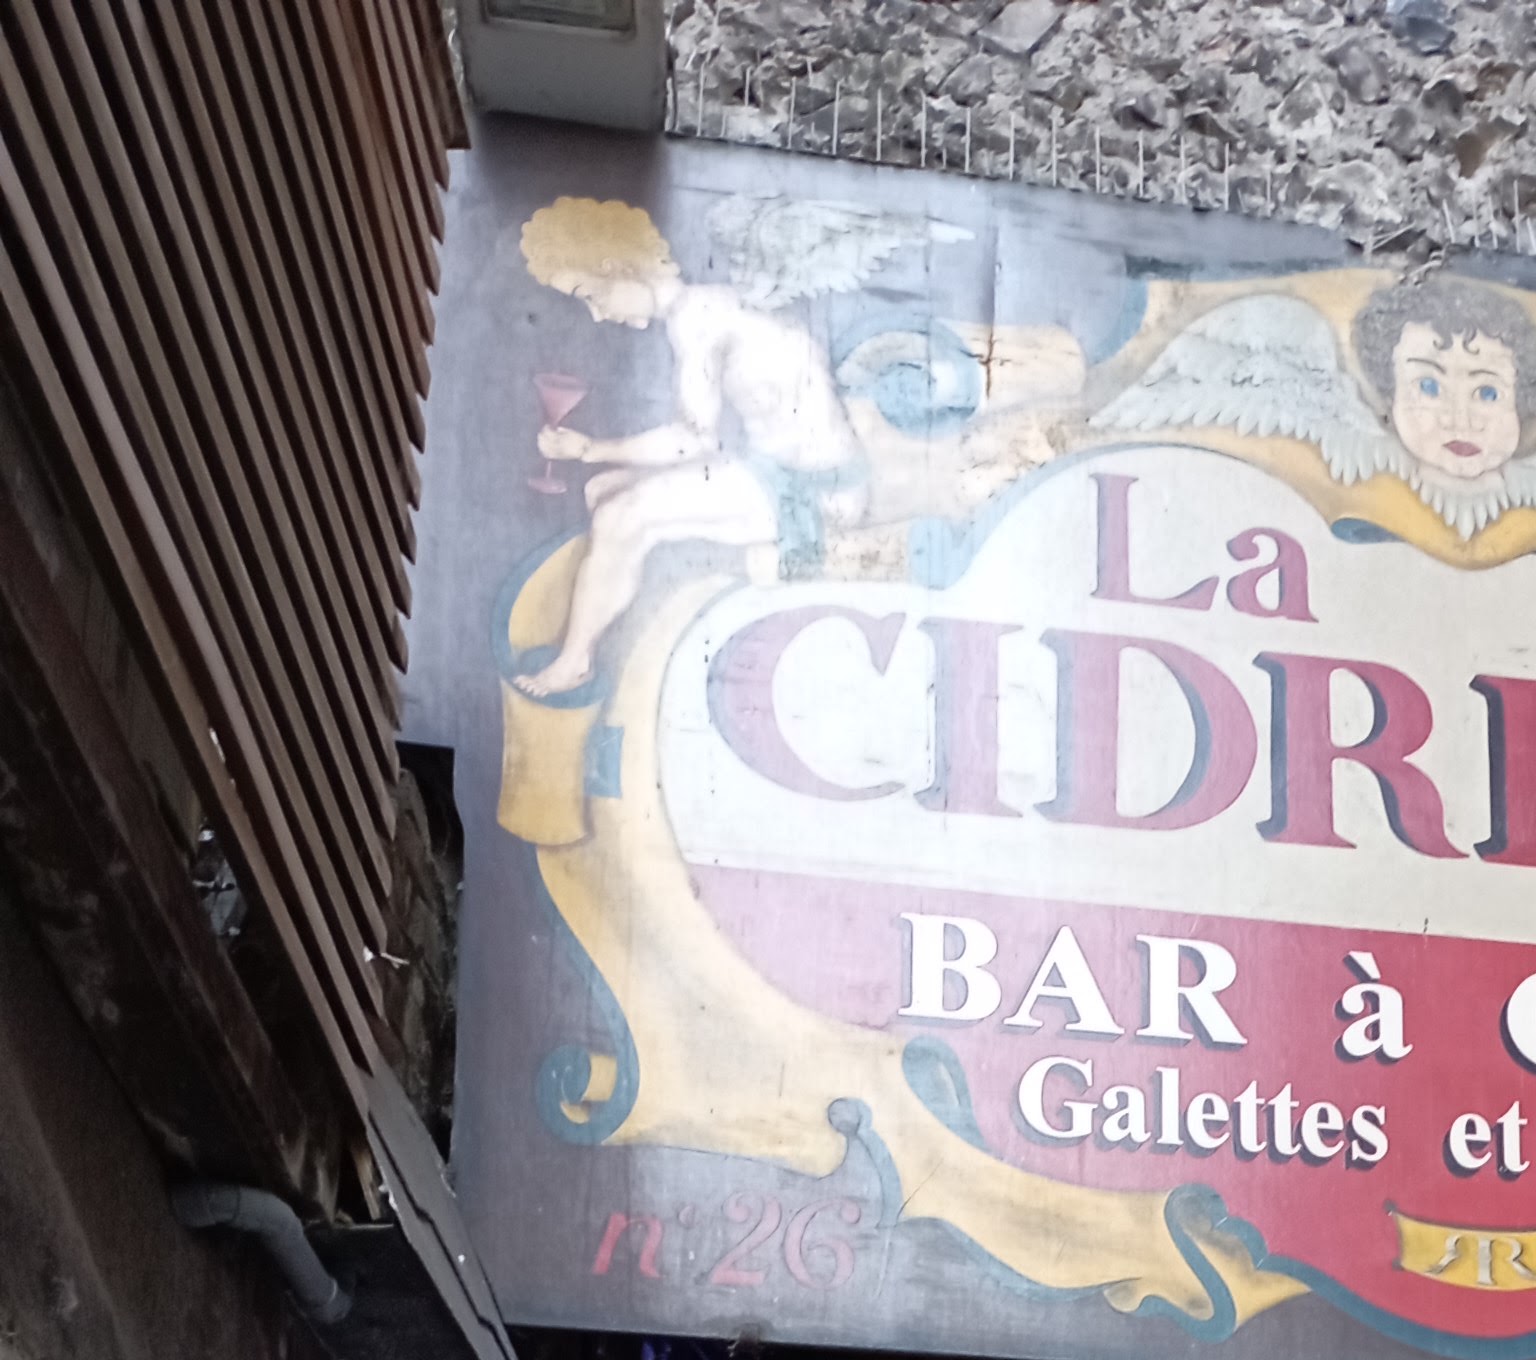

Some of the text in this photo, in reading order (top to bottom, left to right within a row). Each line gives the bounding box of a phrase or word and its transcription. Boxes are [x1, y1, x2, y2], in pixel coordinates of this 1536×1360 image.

[1088, 473, 1319, 623] La
[897, 911, 1249, 1046] BAR
[1336, 950, 1414, 1062] à
[1017, 1054, 1390, 1164] Galettes
[1447, 1100, 1531, 1175] et
[709, 1189, 856, 1291] 26
